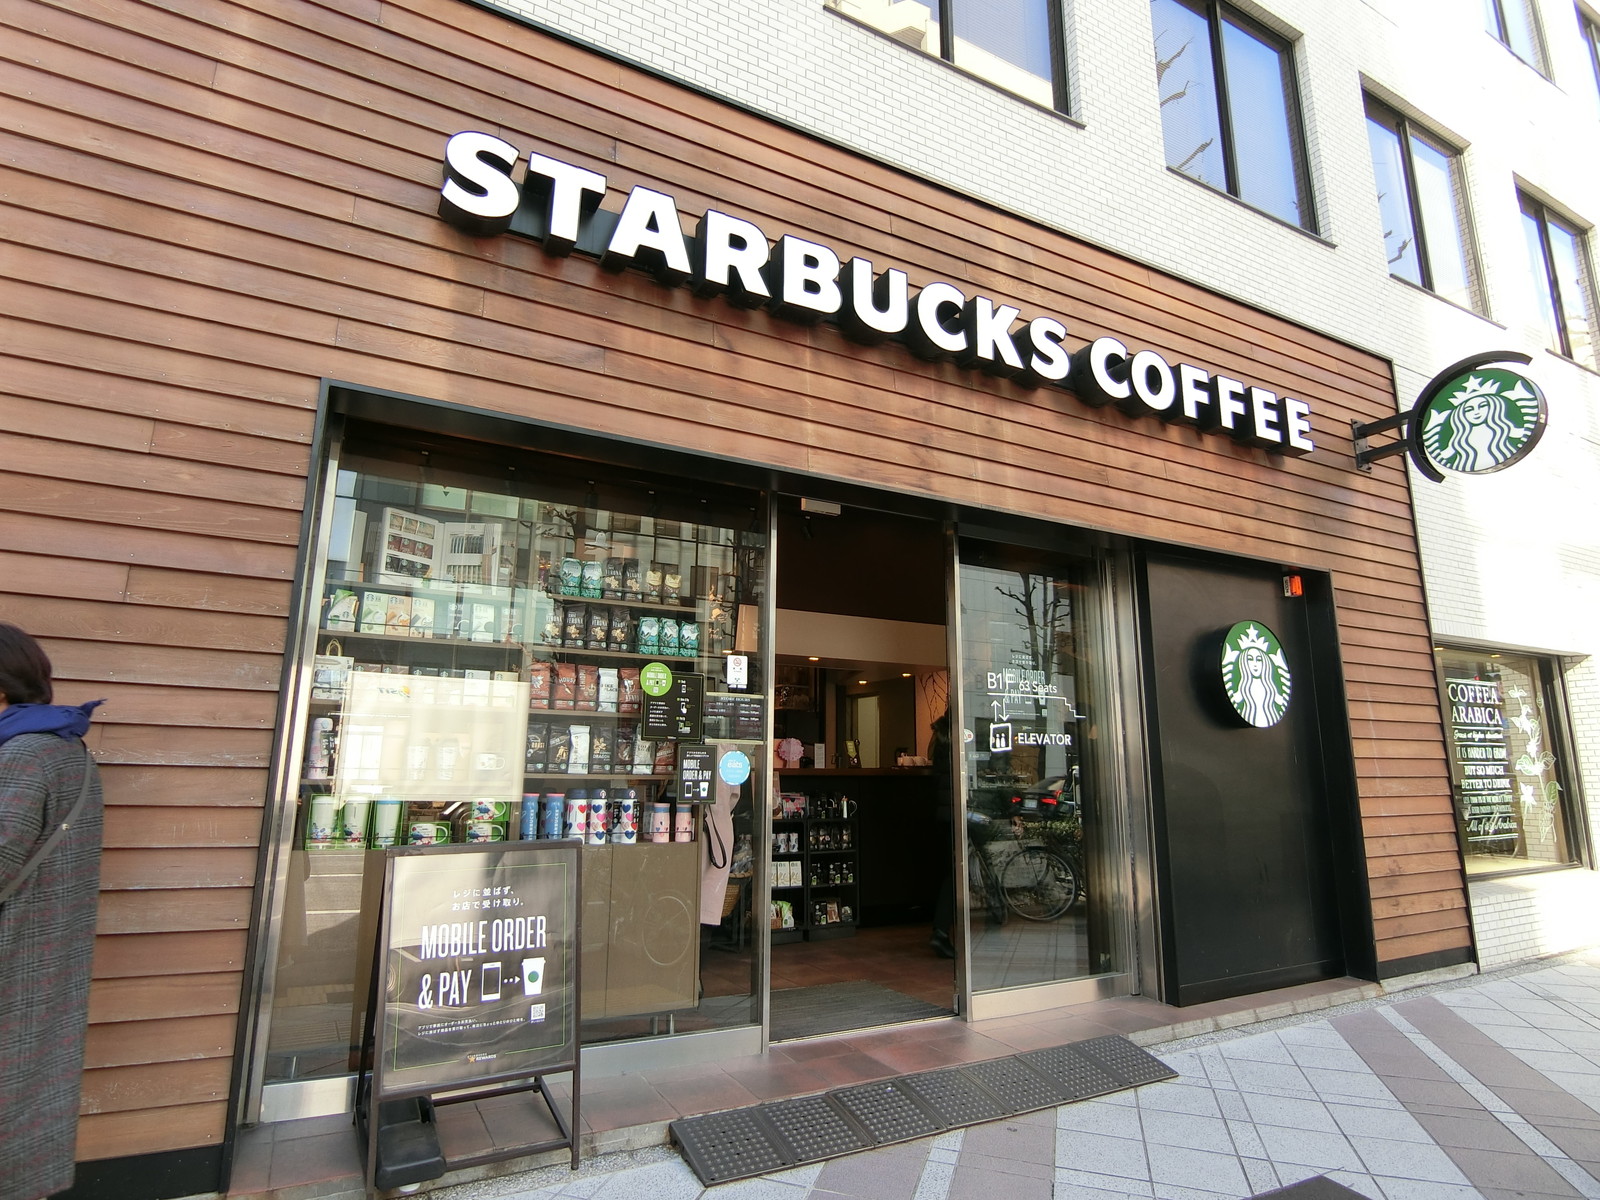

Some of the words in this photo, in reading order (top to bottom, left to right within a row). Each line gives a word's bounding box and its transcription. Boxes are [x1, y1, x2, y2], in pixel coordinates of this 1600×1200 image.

[440, 130, 1070, 381] STARBUCKS
[1089, 336, 1315, 453] COFFEE
[987, 671, 1015, 690] B1F
[1018, 680, 1030, 692] 63
[1032, 681, 1058, 694] Seats
[1448, 684, 1503, 705] COFFEA
[1452, 705, 1503, 725] ARABICA
[1017, 732, 1072, 746] ELEVATOR
[683, 759, 700, 769] MOBILE
[1463, 765, 1476, 776] BUT
[1476, 765, 1485, 775] SO
[1485, 765, 1504, 776] MUCH
[683, 770, 698, 780] ORDER
[698, 770, 703, 780] &
[703, 770, 712, 780] PAY
[1460, 779, 1483, 789] BETTER
[1483, 778, 1492, 788] TO
[1492, 778, 1511, 789] DRINK
[453, 886, 515, 899] レジに並ばず、
[452, 897, 524, 911] お店で受け取り。
[421, 920, 487, 960] MOBILE
[491, 915, 547, 952] ORDER
[418, 973, 433, 1009] &
[438, 969, 472, 1007] PAY
